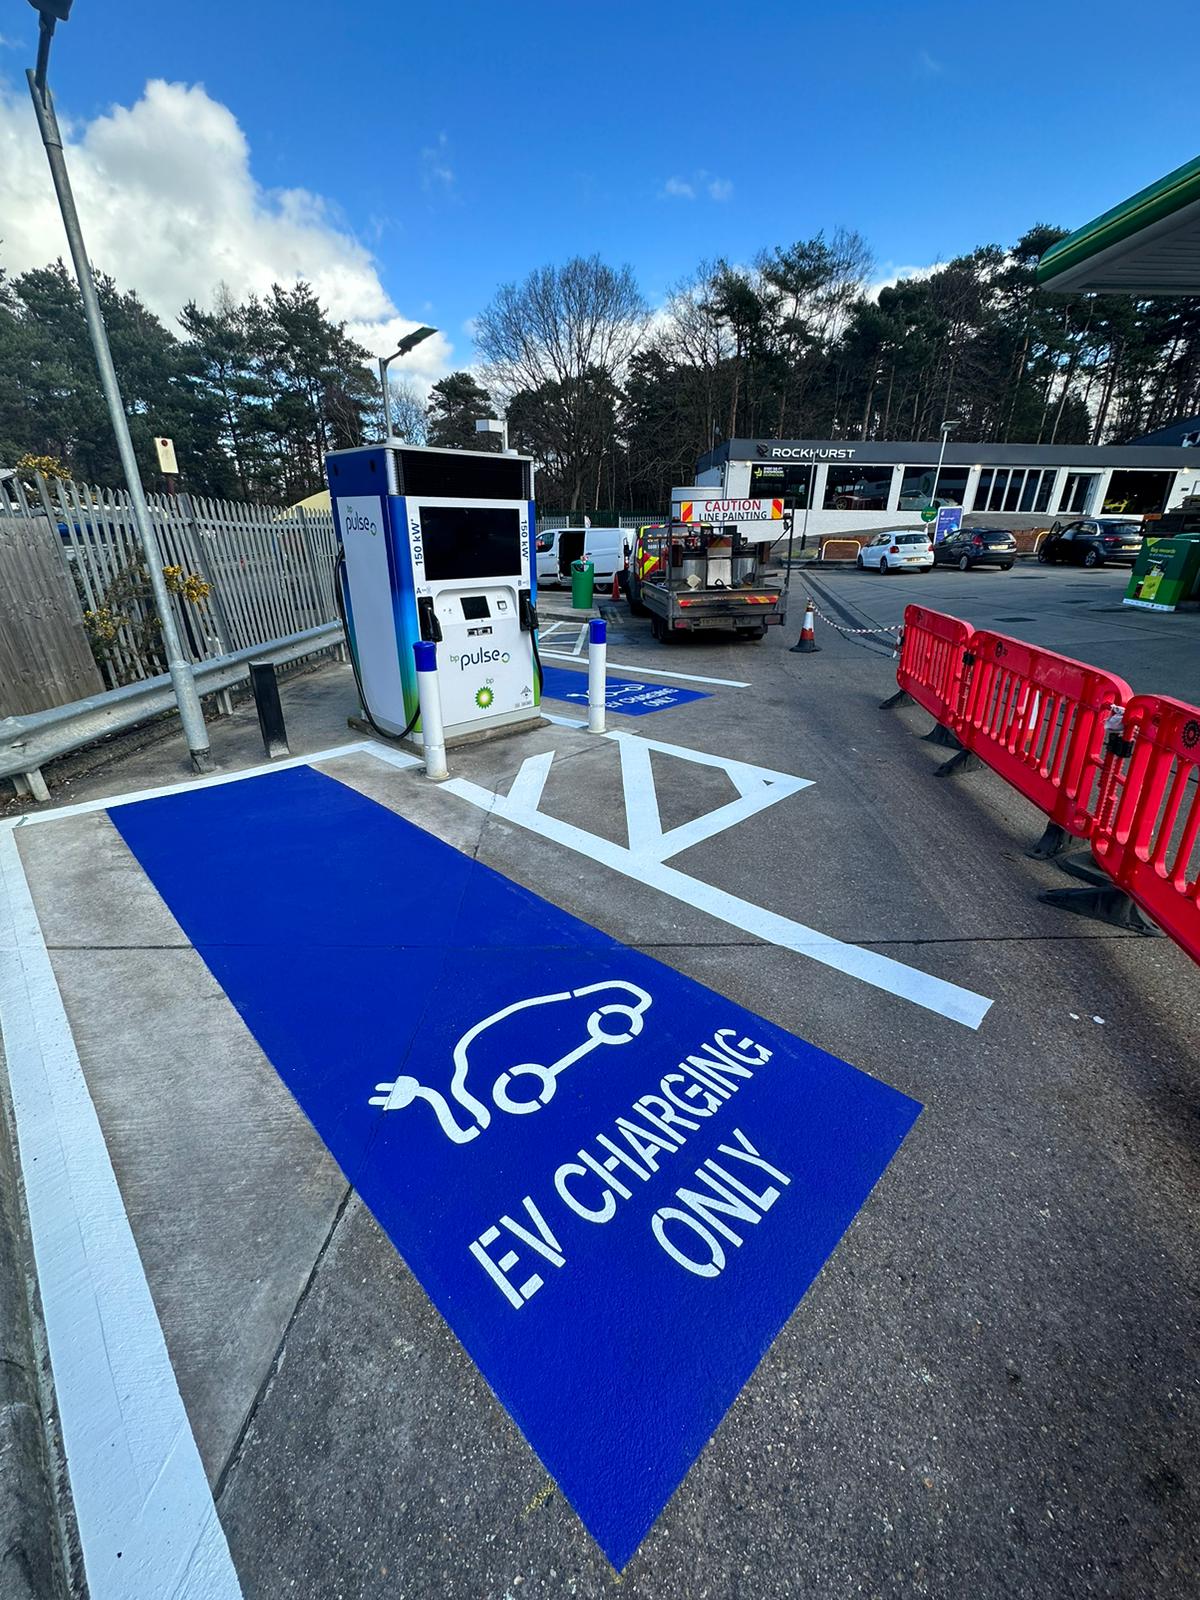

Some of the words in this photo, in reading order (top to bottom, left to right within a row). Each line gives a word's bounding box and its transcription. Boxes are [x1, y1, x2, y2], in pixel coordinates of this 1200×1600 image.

[772, 448, 855, 458] ROCKHURST
[699, 512, 719, 521] LINE
[723, 510, 767, 521] PAINTING
[705, 500, 760, 512] CAUTION
[345, 511, 370, 534] pulse
[521, 520, 529, 538] 150
[413, 546, 424, 567] 150
[460, 647, 500, 671] pulse
[469, 1196, 566, 1310] EV
[554, 1029, 773, 1224] CHARGING
[651, 1128, 791, 1278] ONLY
